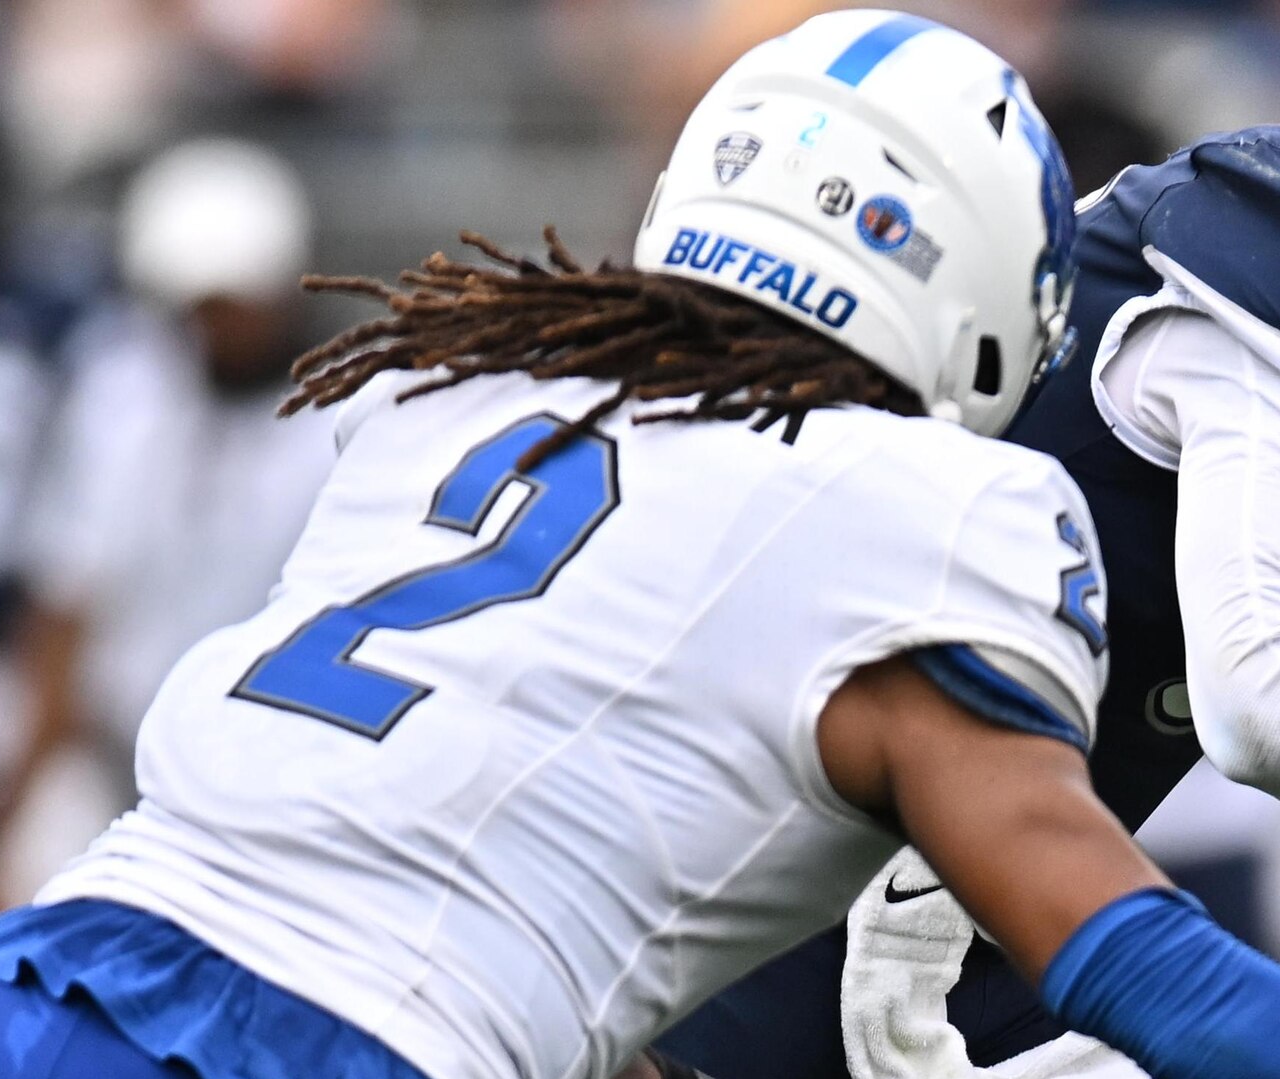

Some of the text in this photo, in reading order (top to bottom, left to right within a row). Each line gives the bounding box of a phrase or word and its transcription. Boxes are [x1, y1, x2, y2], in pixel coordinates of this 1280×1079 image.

[798, 111, 828, 148] 2
[662, 227, 858, 330] BUFFALO
[228, 410, 622, 742] 2
